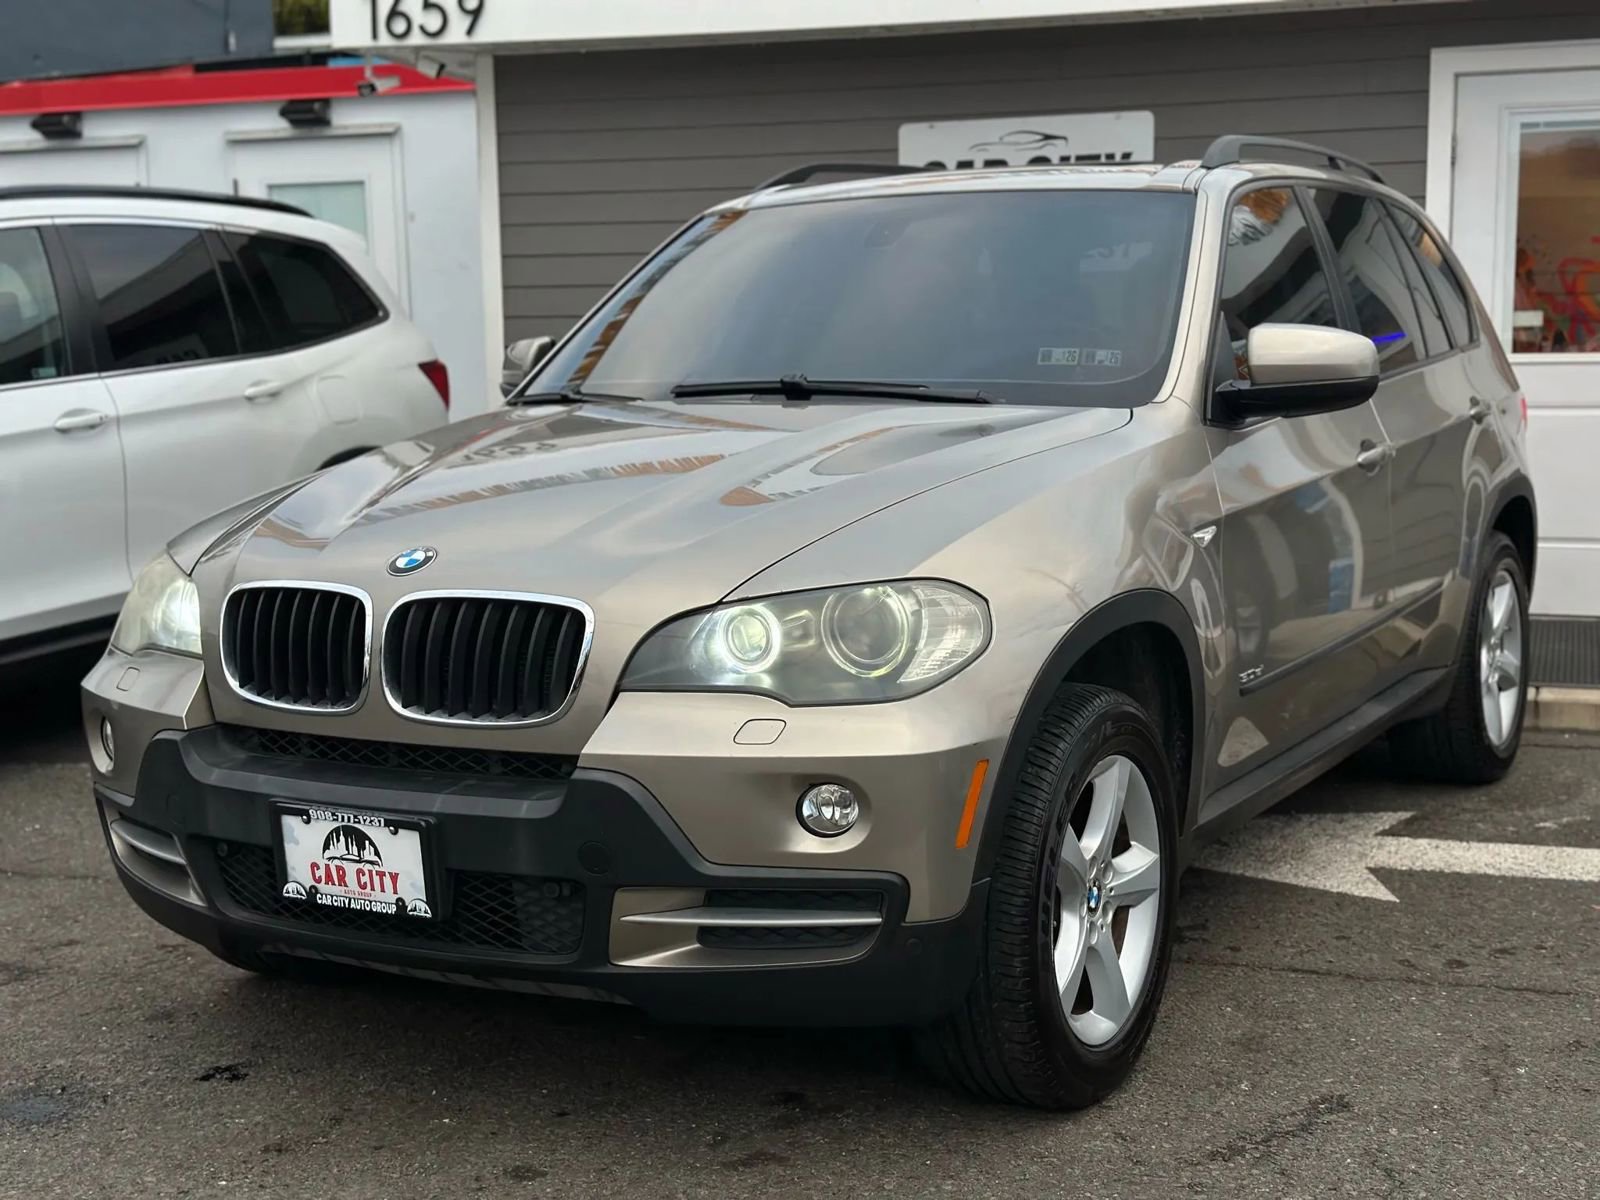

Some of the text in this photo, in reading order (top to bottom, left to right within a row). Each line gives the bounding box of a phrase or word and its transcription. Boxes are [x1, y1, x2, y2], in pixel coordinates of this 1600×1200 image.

[371, 0, 485, 40] 1659
[308, 809, 385, 827] 908-777-1237
[310, 861, 400, 895] CAR CITY
[316, 893, 397, 915] CAR CITY AUTO GROUP
